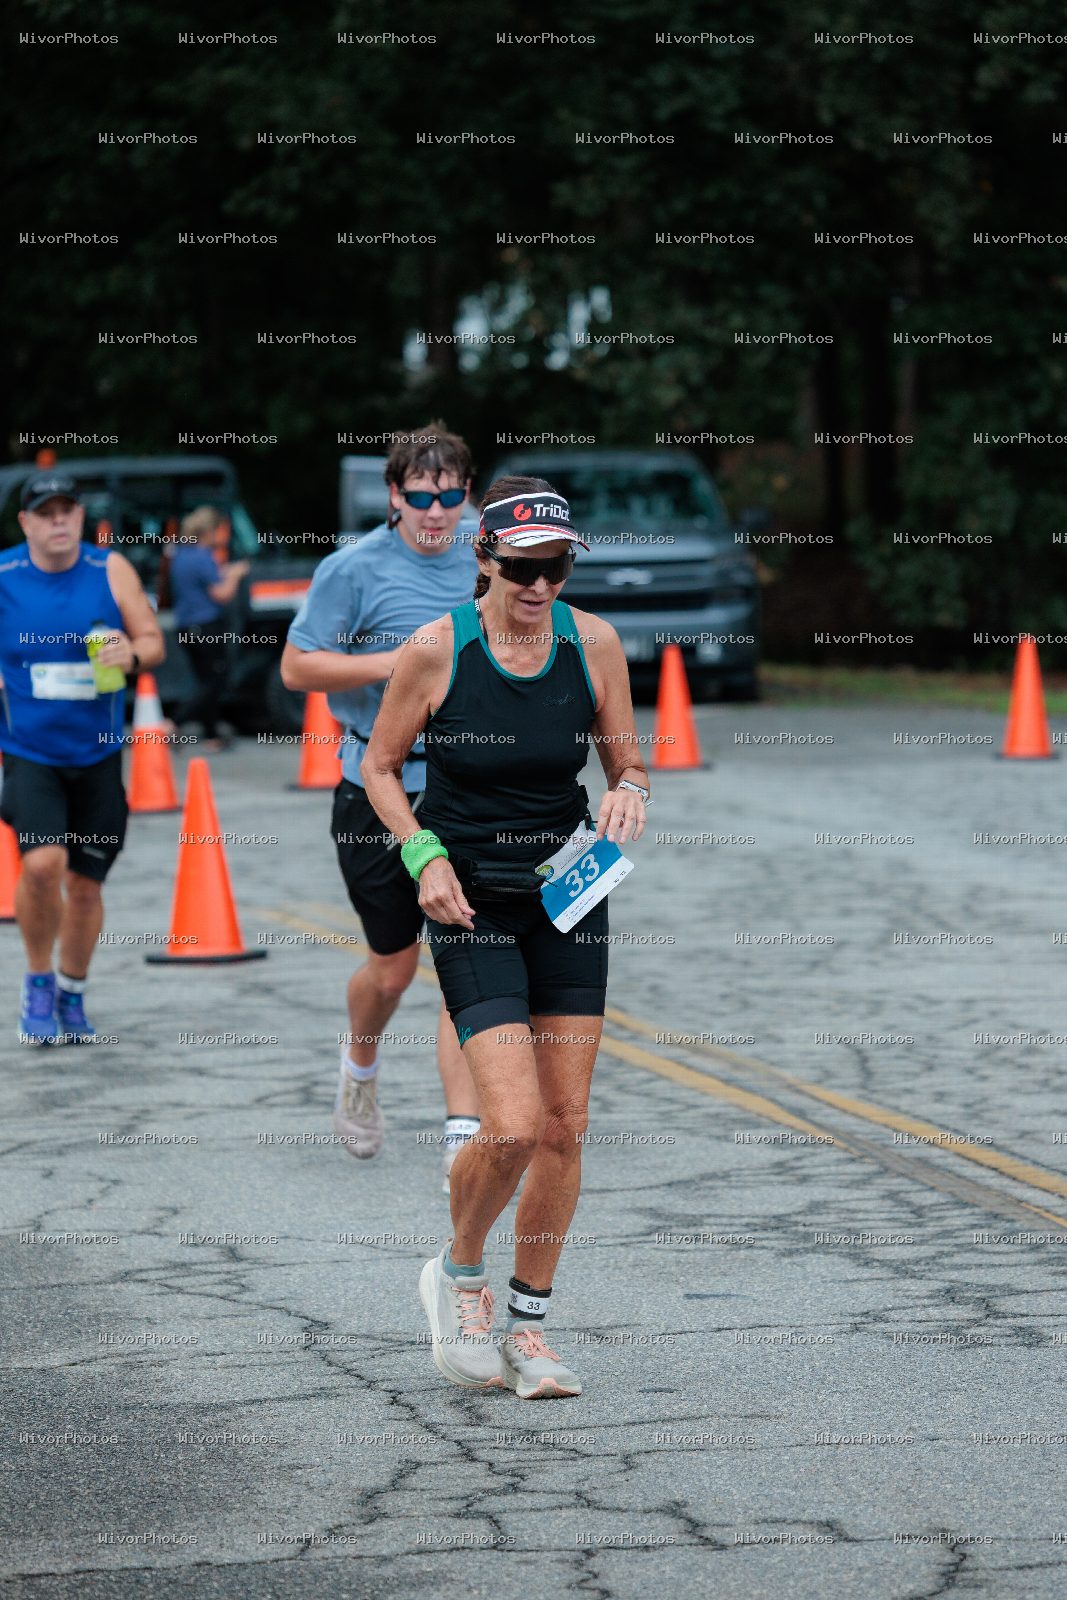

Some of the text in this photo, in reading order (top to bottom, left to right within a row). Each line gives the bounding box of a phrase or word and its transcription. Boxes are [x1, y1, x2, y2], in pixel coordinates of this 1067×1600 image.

[534, 503, 570, 522] TriDot
[565, 853, 600, 898] 33
[527, 1301, 540, 1311] 33
